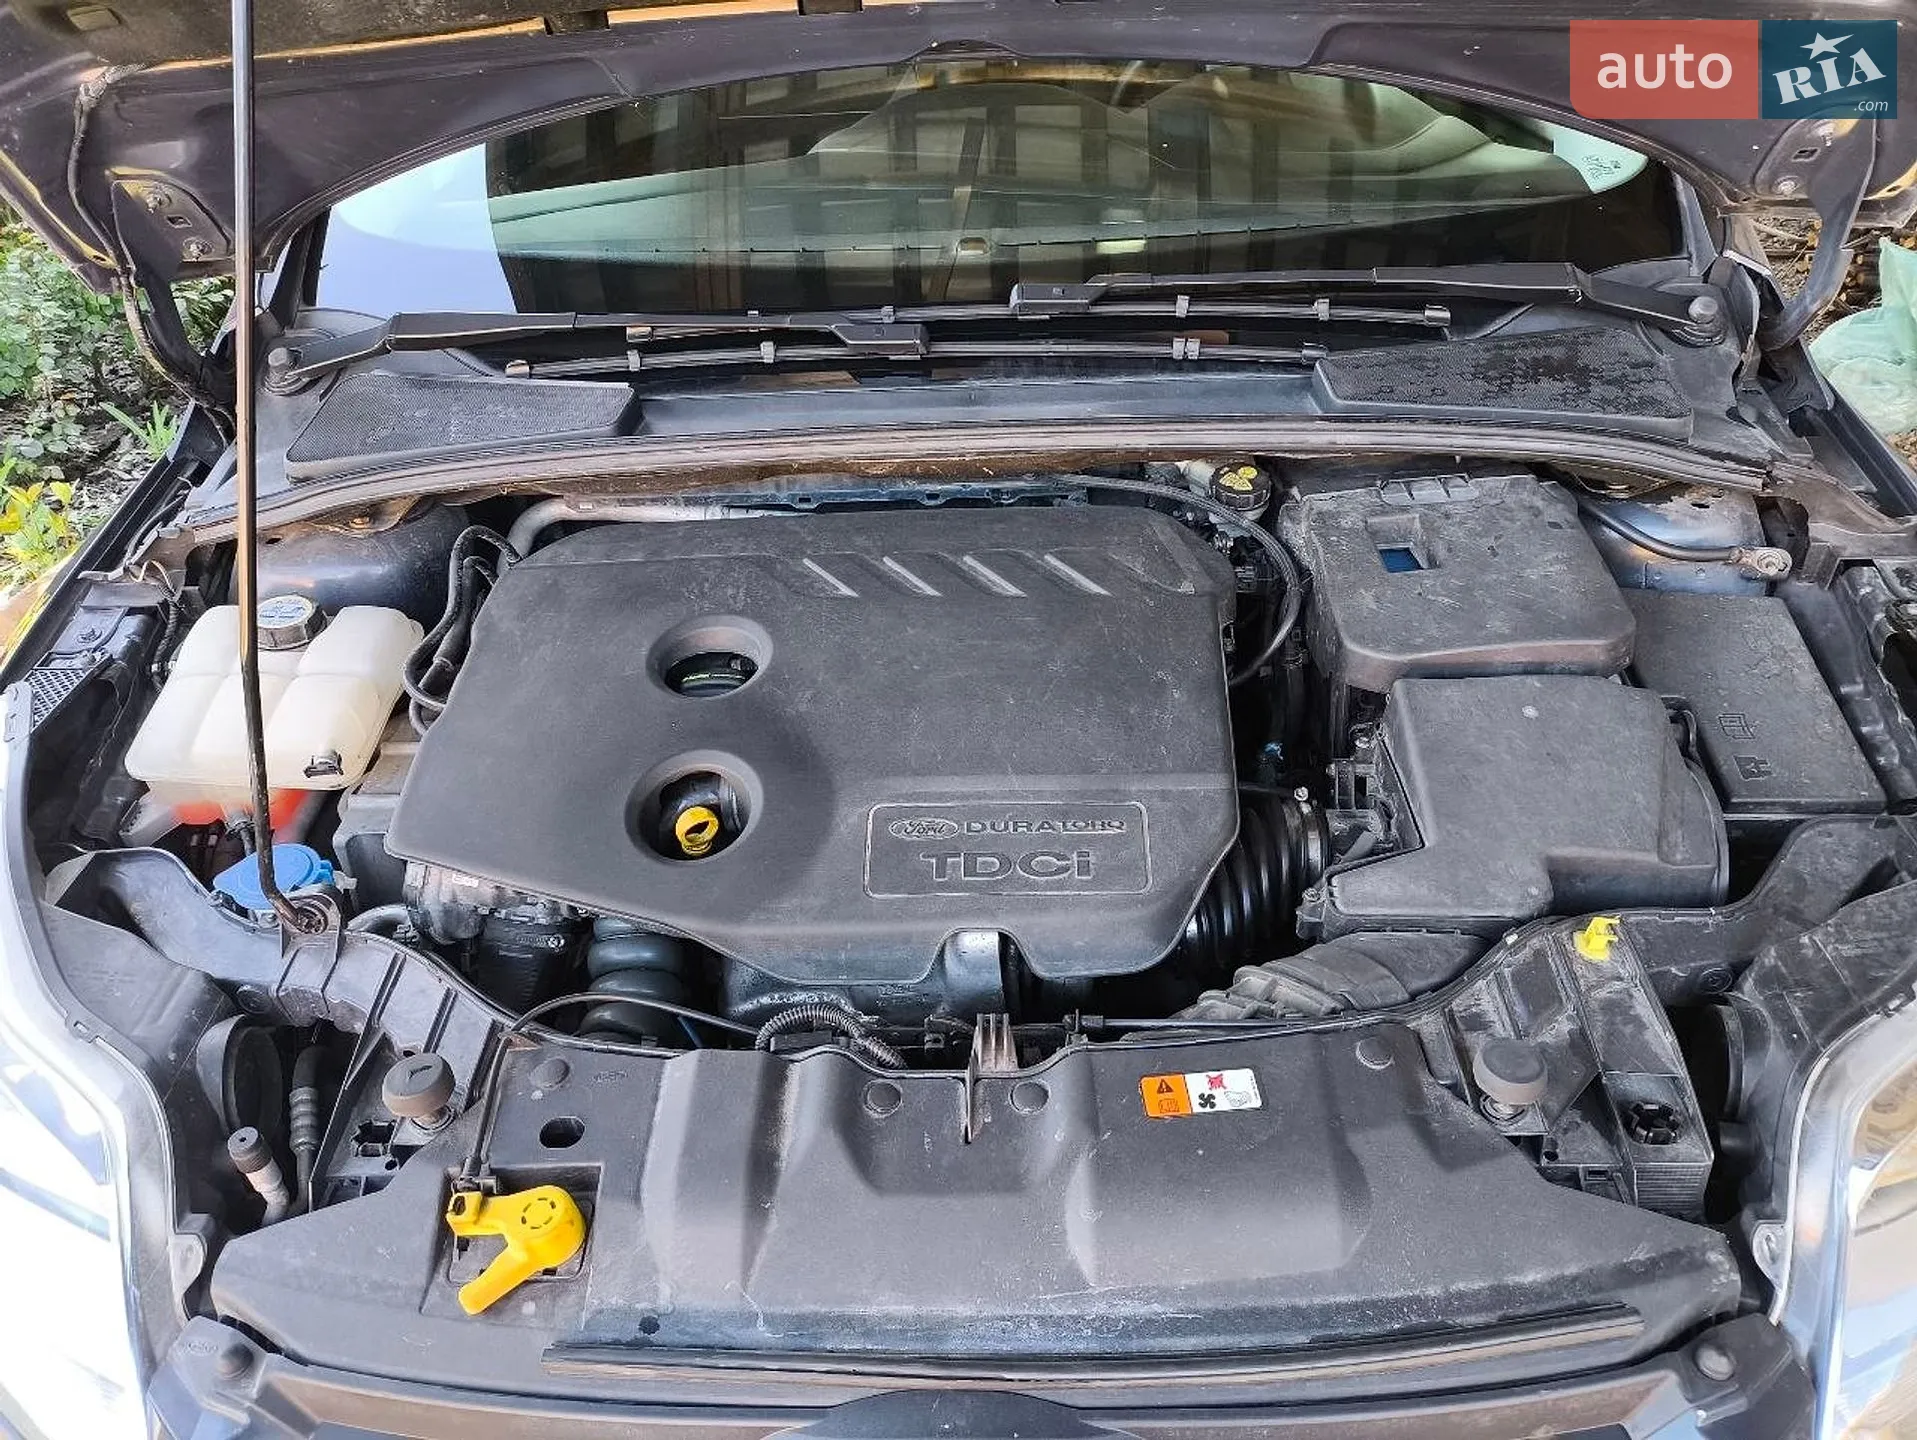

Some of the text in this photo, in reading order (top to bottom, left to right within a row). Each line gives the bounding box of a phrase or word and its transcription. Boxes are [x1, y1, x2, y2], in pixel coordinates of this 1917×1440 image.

[901, 820, 1127, 837] Ford DURATORQ
[921, 850, 1093, 881] TDCi
